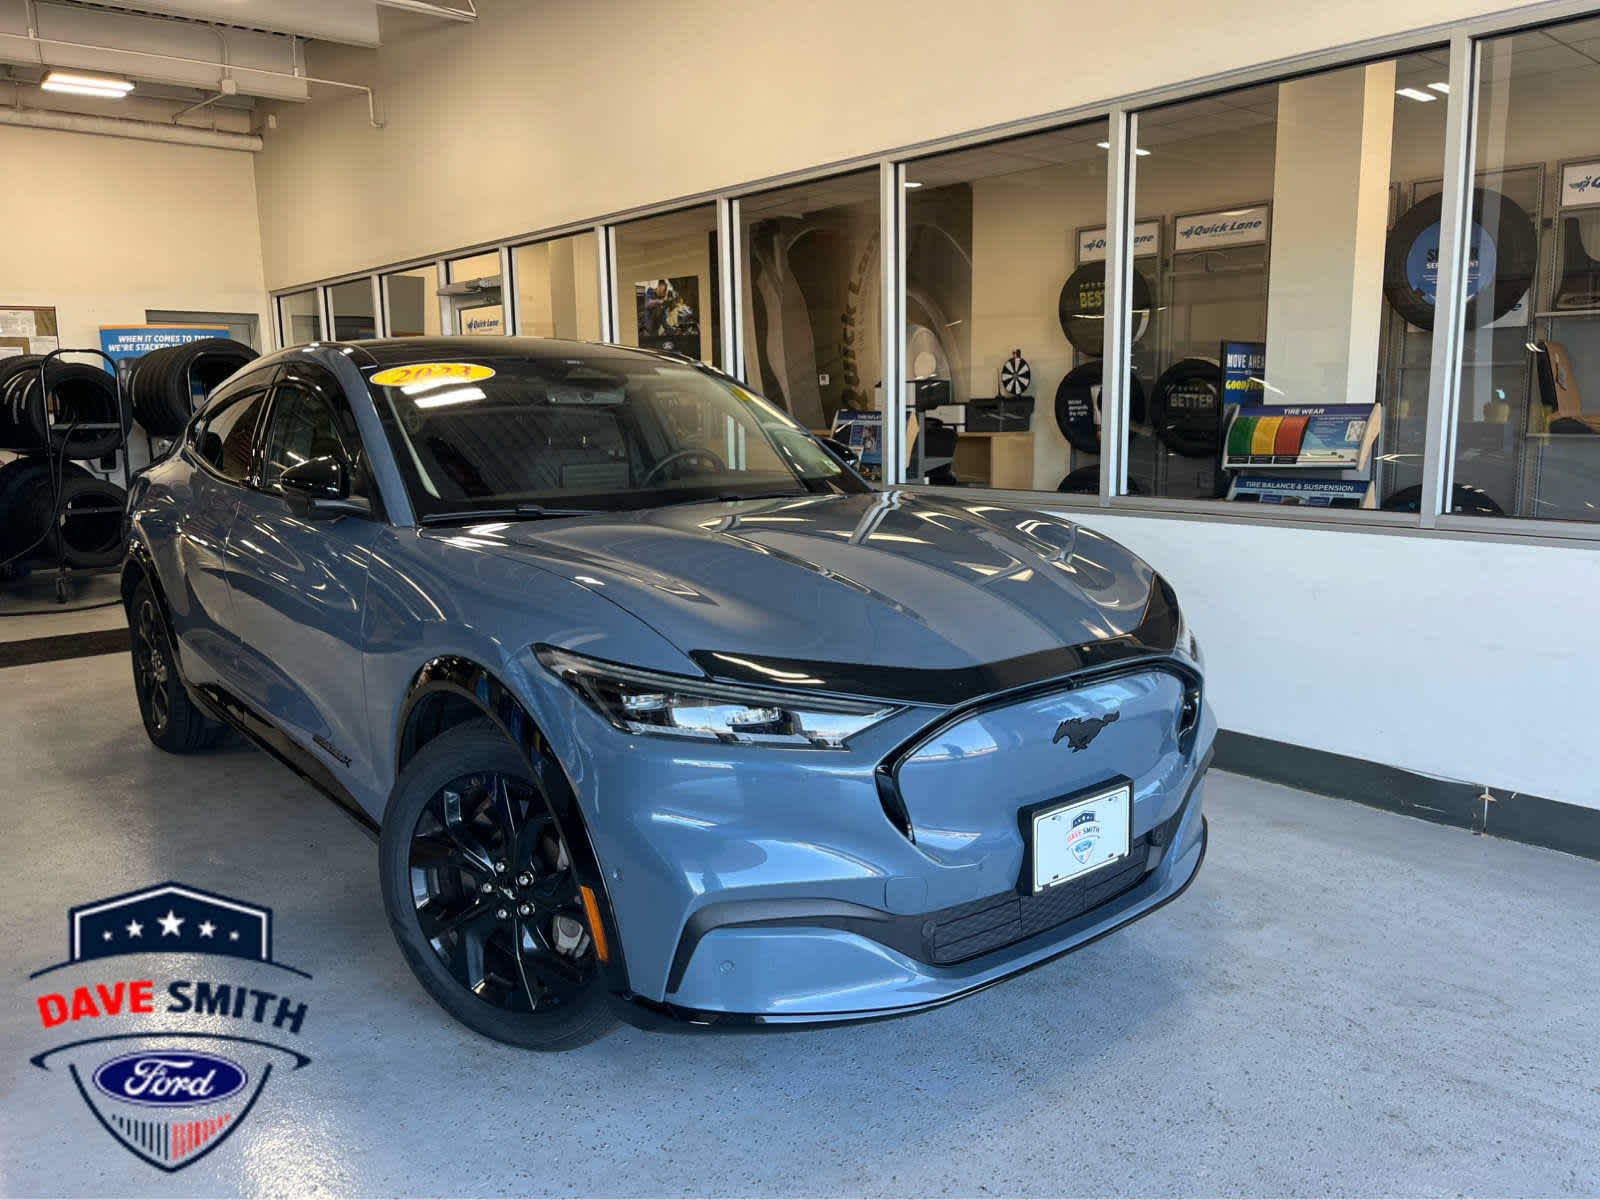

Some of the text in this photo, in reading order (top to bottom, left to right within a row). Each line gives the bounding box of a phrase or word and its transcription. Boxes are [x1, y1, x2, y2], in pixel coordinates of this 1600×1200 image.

[1194, 223, 1229, 236] Quick
[1229, 220, 1262, 231] Lane
[1134, 234, 1155, 244] ane
[1080, 291, 1104, 308] BES
[118, 335, 143, 344] WHEN
[144, 335, 153, 343] IT
[153, 335, 181, 343] COMES
[182, 335, 192, 343] TO
[108, 343, 135, 353] WE'RE
[1227, 354, 1265, 369] MOVE AHEA
[1170, 393, 1214, 408] BETTER
[1284, 407, 1325, 416] TIRE WEAR
[1245, 481, 1261, 489] TIRE
[1261, 482, 1296, 490] BALANCE
[1303, 483, 1355, 492] SUSPENSION
[1083, 826, 1100, 835] SMITH
